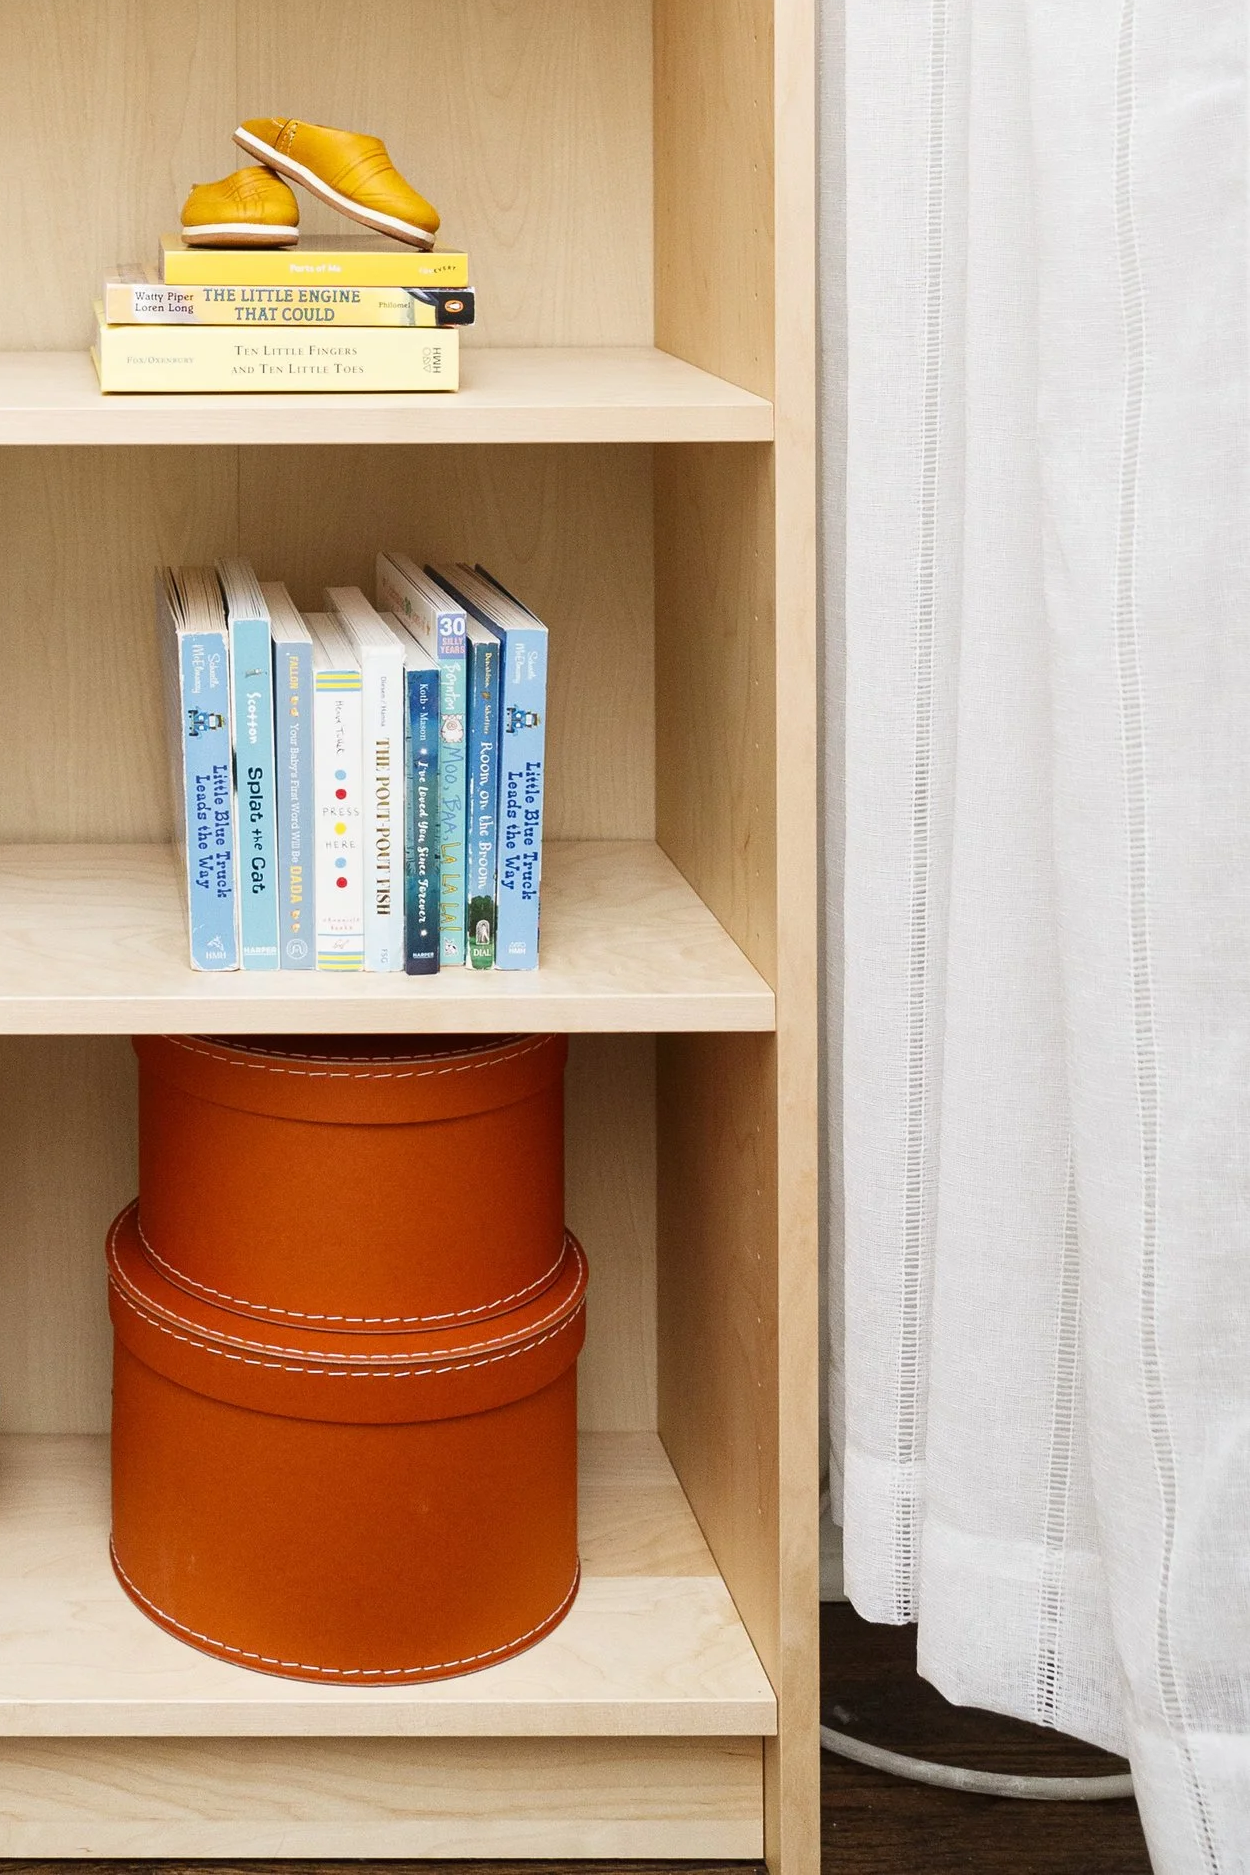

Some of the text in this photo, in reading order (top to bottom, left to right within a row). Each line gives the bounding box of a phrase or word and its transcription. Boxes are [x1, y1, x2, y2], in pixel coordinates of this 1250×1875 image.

[135, 292, 194, 303] Watty Piper
[203, 288, 361, 303] THE LITTLE ENGINE
[378, 301, 411, 309] Philomel
[135, 303, 194, 314] Loren Long
[235, 307, 335, 321] THAT COULD
[234, 345, 358, 356] TEN LITTLE FINGERS
[433, 347, 442, 373] HMH
[232, 363, 364, 374] AND TEN LITTLE TOES
[440, 617, 466, 637] 30
[440, 645, 465, 654] YEARS
[442, 637, 464, 645] SILLY
[290, 656, 298, 689] FALLON
[441, 661, 462, 711] Boynton
[246, 692, 261, 745] Scotton
[419, 683, 428, 741] Kotb Mason
[290, 723, 302, 904] Your Baby's First Word Will Be DADA
[323, 807, 360, 817] PRESS
[478, 741, 493, 889] Room on the Broom
[196, 775, 214, 889] Leads the Way
[213, 765, 232, 898] Little Blue Truck
[247, 767, 266, 894] Splat the Cat
[376, 737, 391, 915] THE POUT-POUT FISH
[502, 771, 523, 890] Leads the Way
[522, 761, 540, 900] Little Blue Truck
[326, 841, 356, 849] HERE
[418, 761, 429, 924] I've Loved You Since Forever
[440, 842, 461, 865] LA
[442, 873, 460, 896] LA
[206, 951, 226, 959] HMH
[473, 949, 492, 957] DIAL
